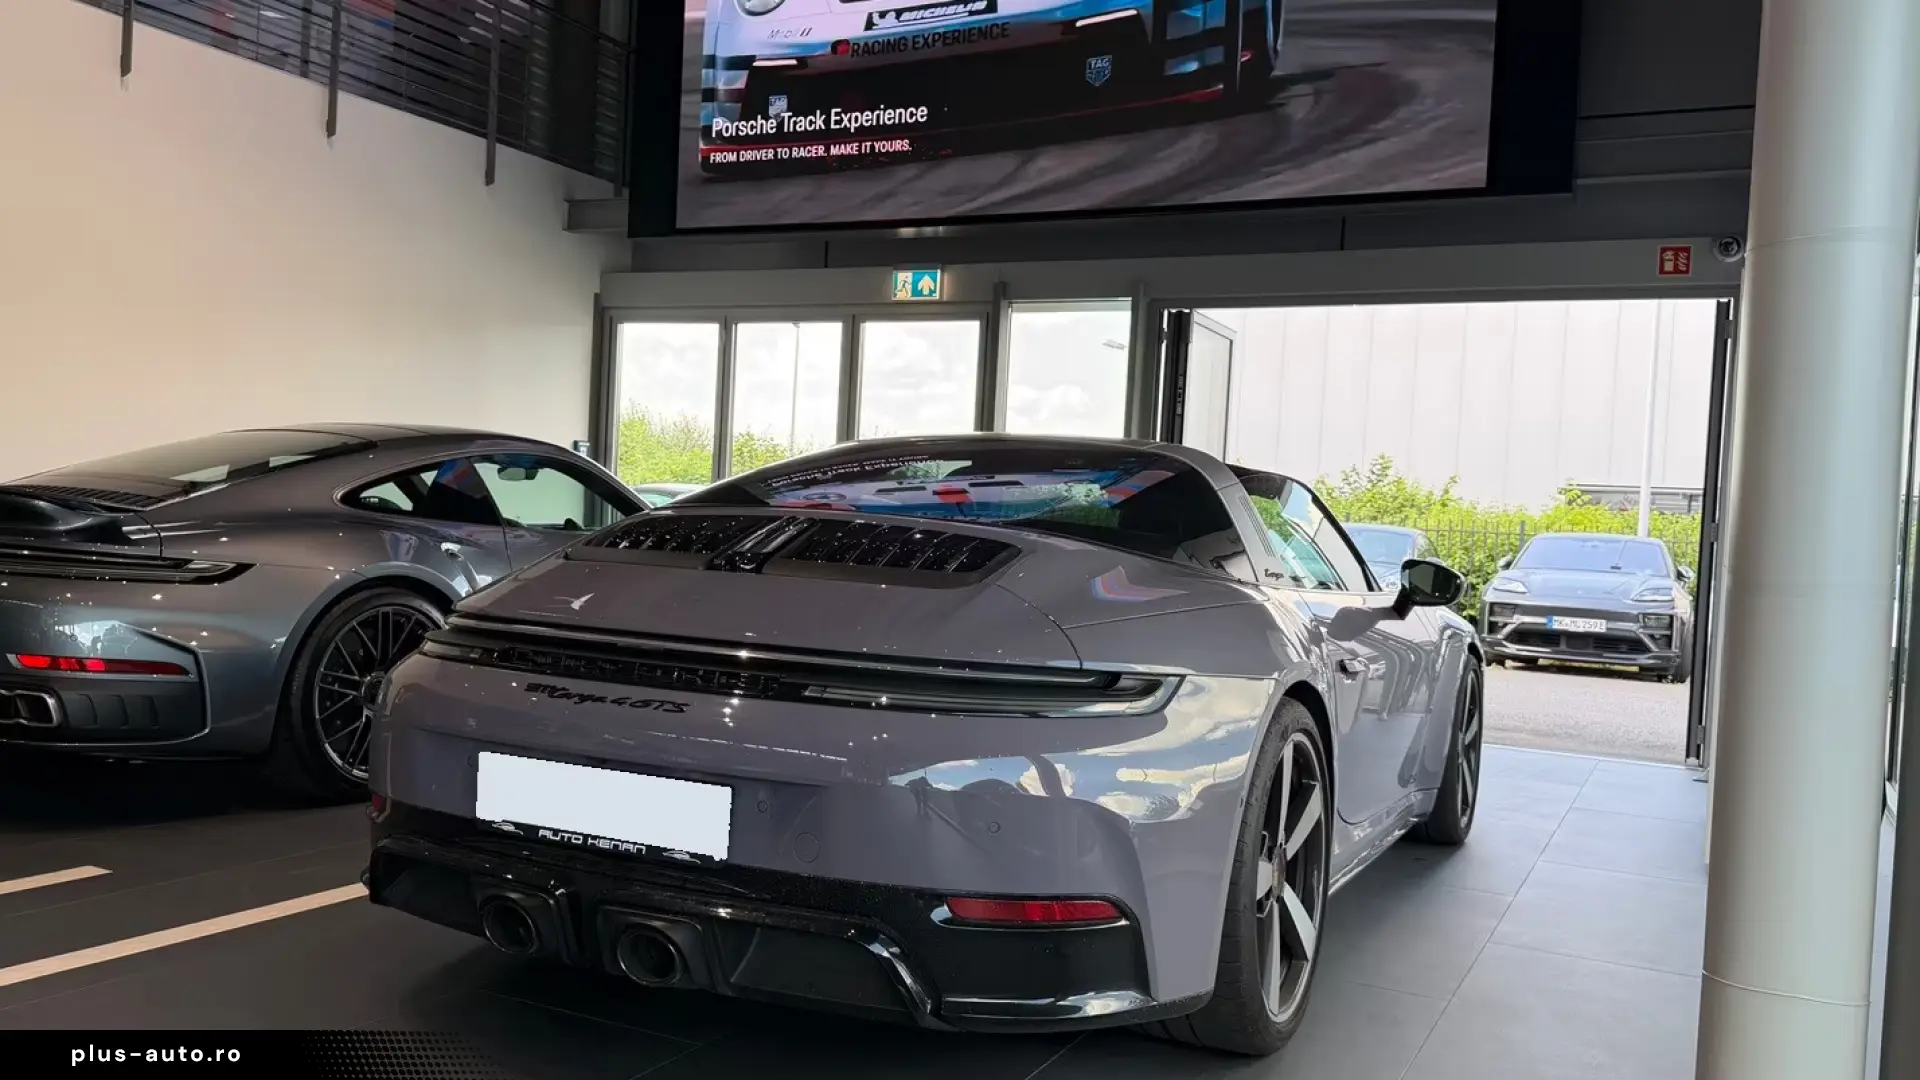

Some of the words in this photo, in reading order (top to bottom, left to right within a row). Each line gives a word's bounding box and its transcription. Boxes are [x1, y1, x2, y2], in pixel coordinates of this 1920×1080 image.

[898, 1, 989, 20] MICHELIN
[851, 35, 909, 58] RACING
[912, 22, 1011, 50] EXPERIENCE
[711, 113, 778, 138] Porsche
[780, 109, 827, 133] Track
[830, 103, 929, 133] Experience
[709, 151, 738, 164] FROM
[740, 148, 774, 162] DRIVER
[776, 146, 790, 159] TO
[792, 144, 828, 158] RACER.
[830, 141, 859, 156] MAKE
[861, 141, 872, 154] IT
[873, 139, 913, 154] YOURS.
[609, 697, 632, 707] 4
[629, 699, 691, 714] GTS
[538, 829, 584, 844] AUTO
[587, 837, 647, 855] KENAN
